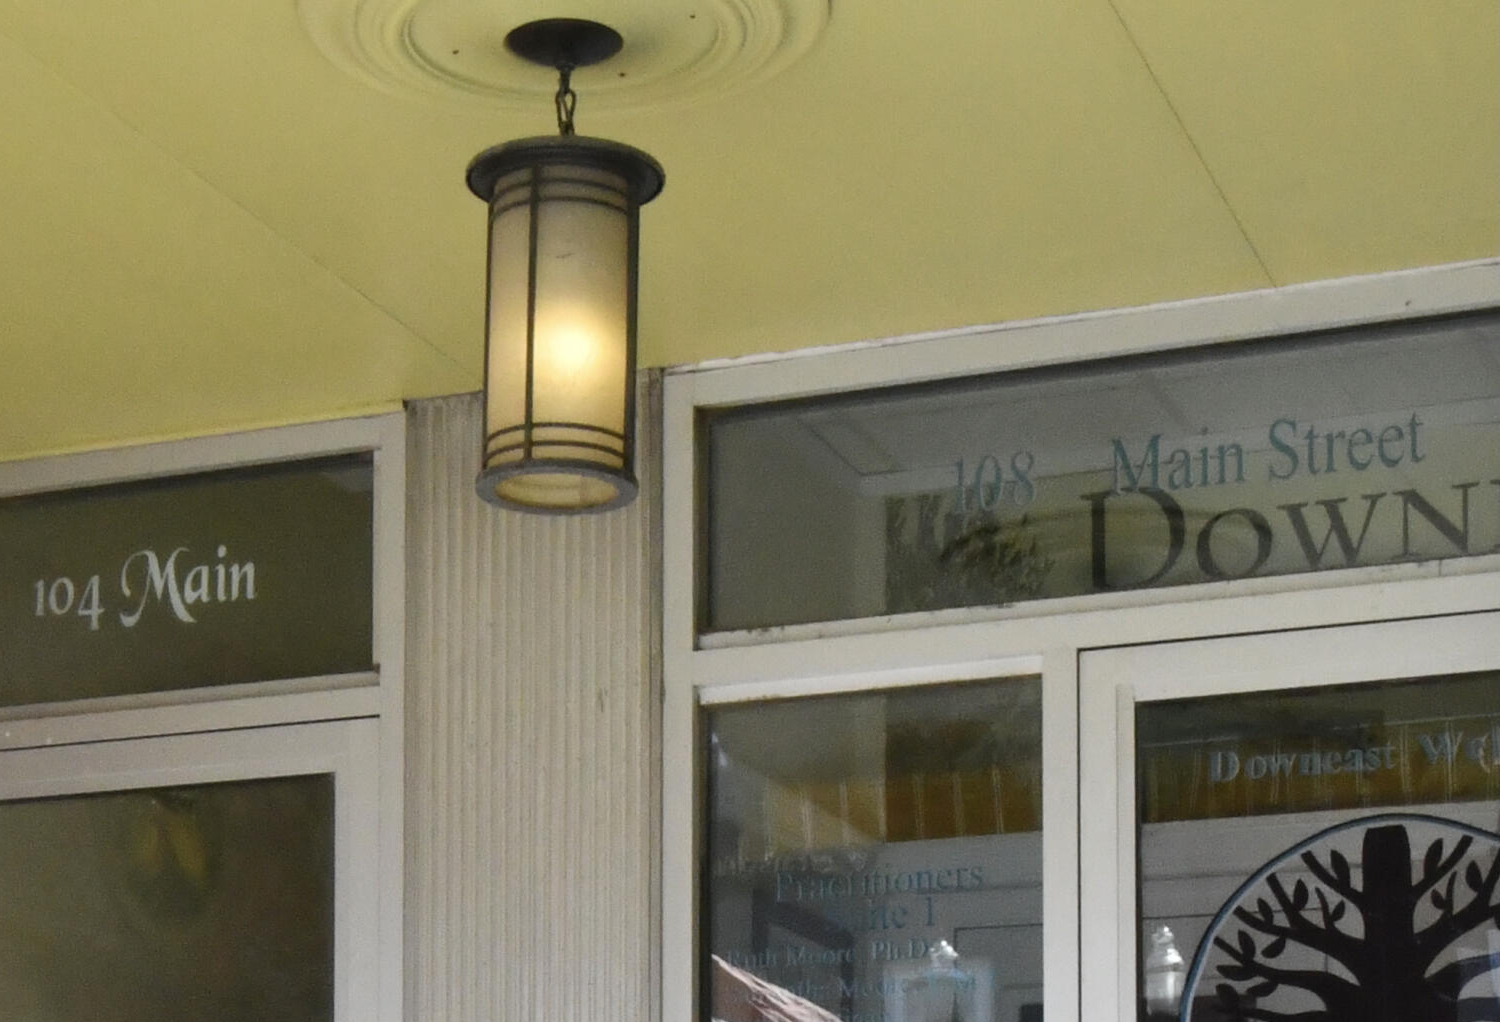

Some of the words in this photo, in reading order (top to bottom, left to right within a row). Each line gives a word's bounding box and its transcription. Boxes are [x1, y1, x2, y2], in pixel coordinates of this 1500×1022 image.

[954, 450, 1037, 513] 108
[1111, 427, 1247, 496] Main
[1267, 413, 1426, 482] Street
[1080, 478, 1500, 592] DOWN
[34, 574, 105, 631] 104
[120, 544, 258, 628] Main
[1208, 743, 1397, 784] Downeast
